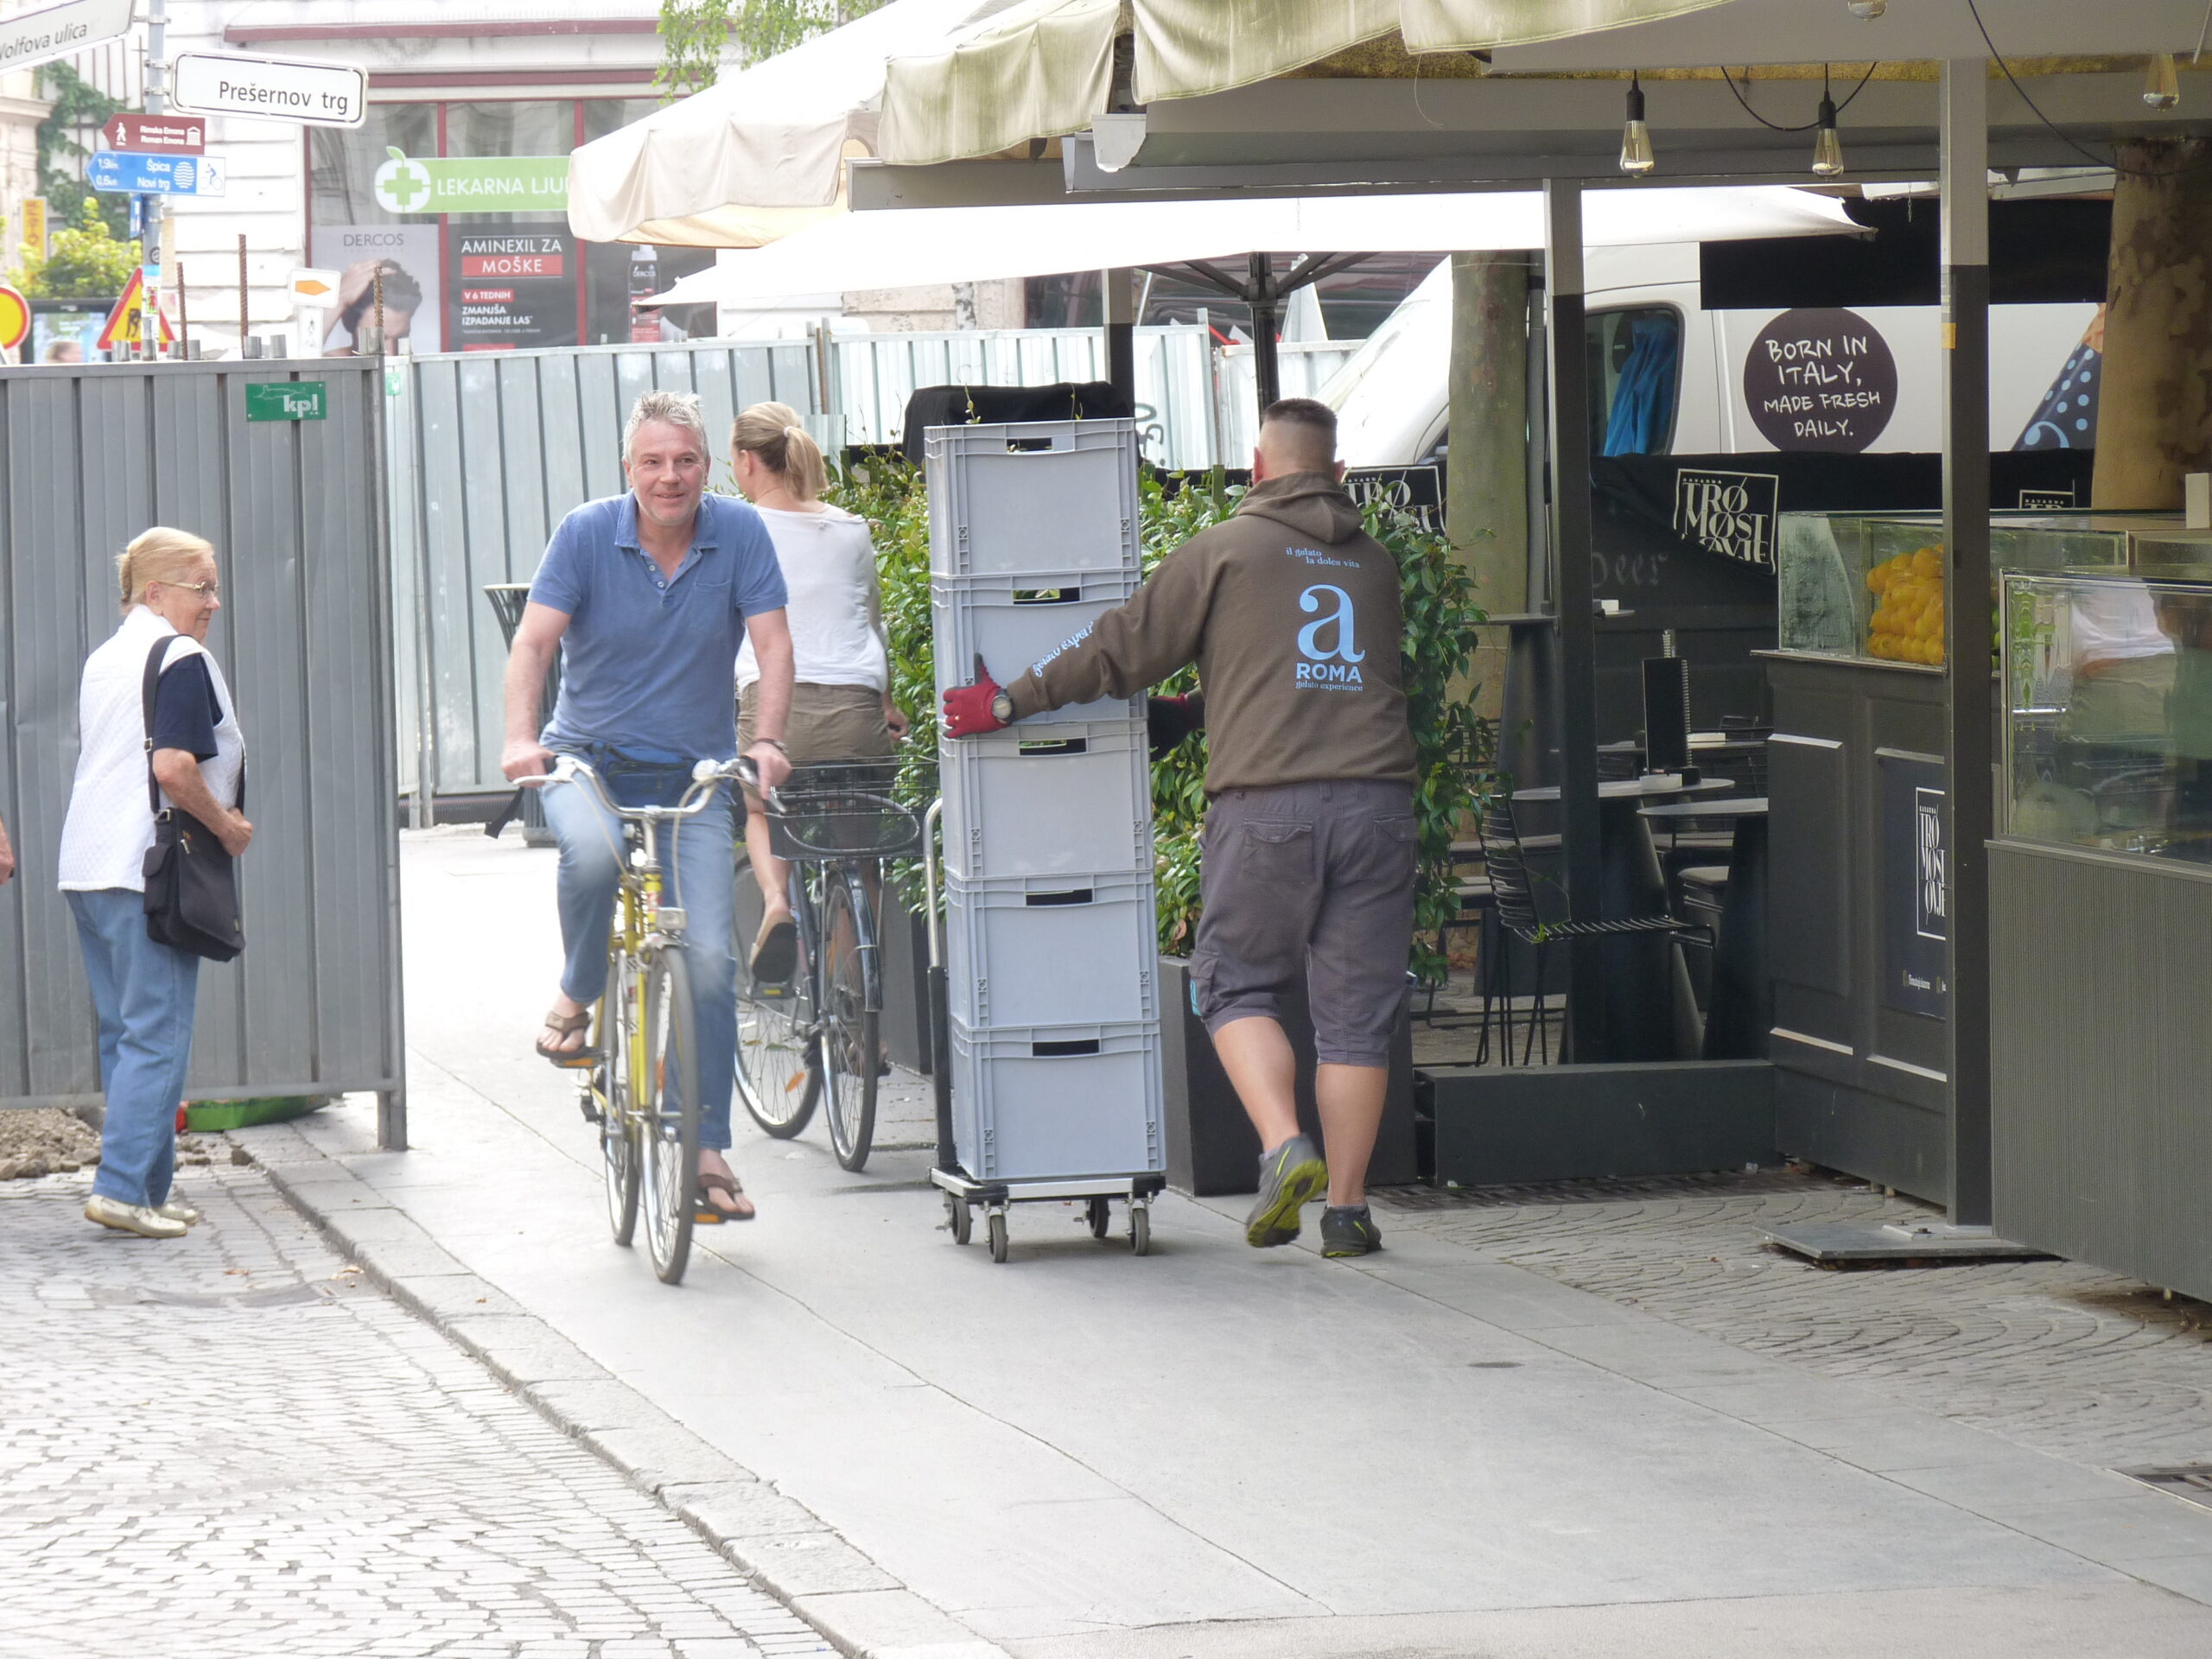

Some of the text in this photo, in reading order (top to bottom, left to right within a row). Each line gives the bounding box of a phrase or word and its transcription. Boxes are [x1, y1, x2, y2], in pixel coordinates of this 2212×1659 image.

[55, 23, 87, 44] ulica
[219, 80, 347, 116] Prešernov trg
[146, 157, 171, 172] Špica
[137, 176, 156, 188] Novi
[158, 178, 170, 191] trg
[437, 177, 524, 196] LEKARNA
[343, 233, 404, 247] DERCOS
[461, 238, 563, 253] AMINEXIL ZA
[482, 256, 543, 273] MOŠKE
[464, 291, 471, 300] V
[480, 290, 512, 300] TEDNIH
[461, 304, 506, 315] ZMANJŠA
[461, 316, 511, 326] IZPADANJE
[1765, 335, 1867, 362] BORN IN
[1778, 361, 1862, 386] ITALY,
[1764, 391, 1880, 414] MADE FRESH
[1794, 419, 1853, 438] DAILY.
[1286, 547, 1322, 557] il gelato
[1306, 556, 1315, 564] la
[1317, 556, 1341, 566] dolce
[1298, 584, 1366, 663] a
[1296, 663, 1363, 683] ROMA
[1295, 680, 1363, 691] gelato experience
